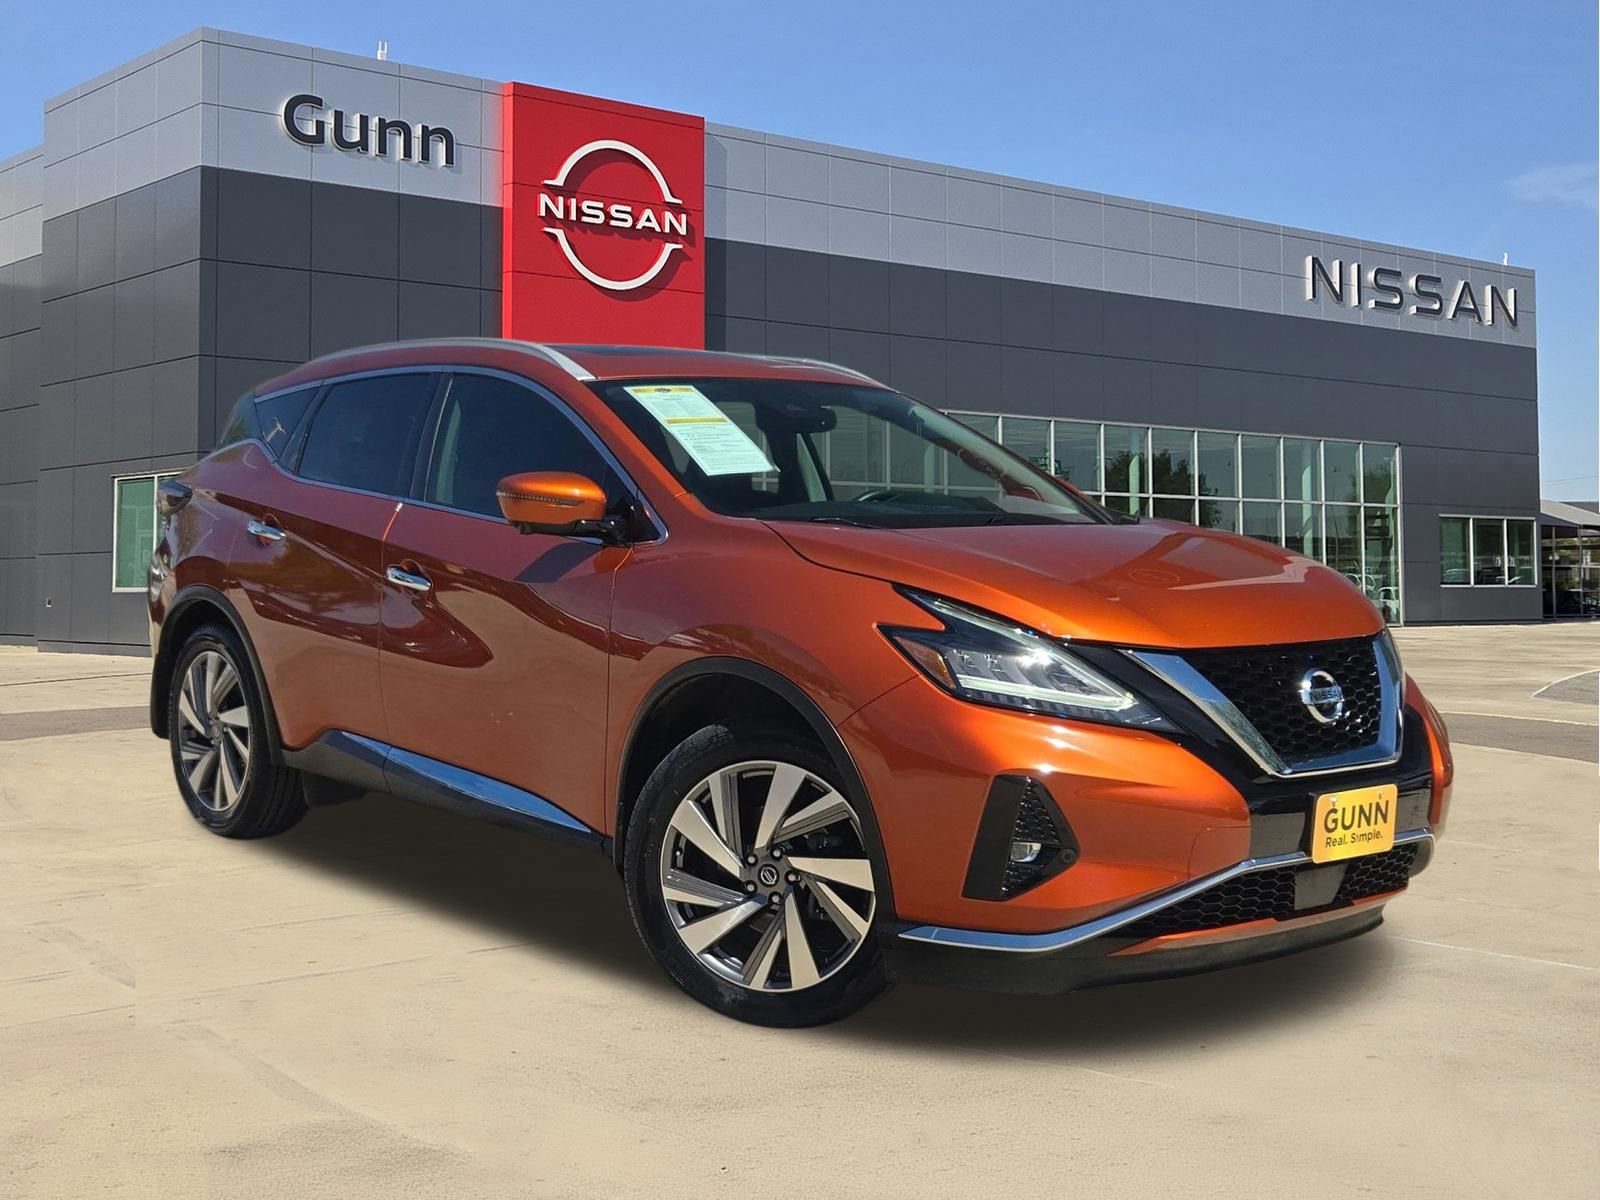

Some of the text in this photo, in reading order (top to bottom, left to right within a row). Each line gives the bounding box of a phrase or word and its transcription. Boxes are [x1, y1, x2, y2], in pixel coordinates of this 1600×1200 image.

[282, 93, 455, 167] Gunn
[538, 192, 687, 236] NISSAN
[1305, 255, 1518, 328] NISSAN
[1323, 799, 1389, 833] GUNN
[1325, 829, 1384, 848] Real. Simple.
